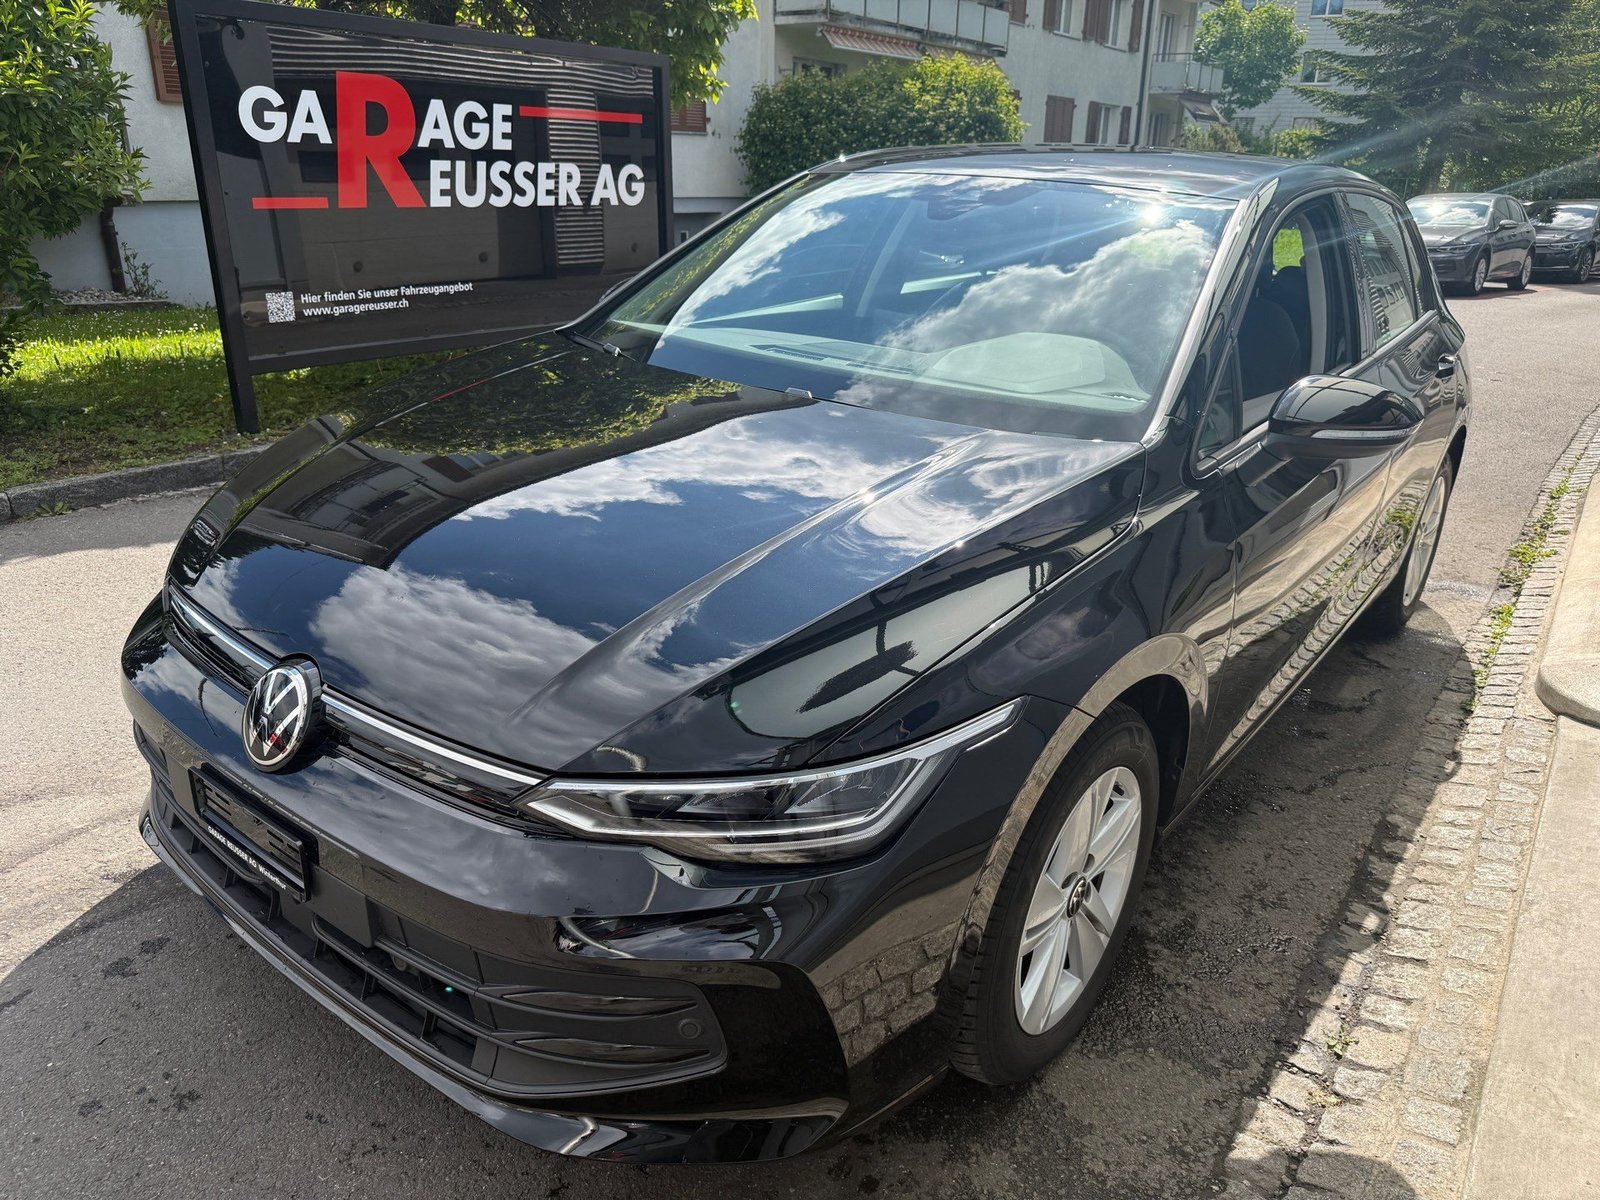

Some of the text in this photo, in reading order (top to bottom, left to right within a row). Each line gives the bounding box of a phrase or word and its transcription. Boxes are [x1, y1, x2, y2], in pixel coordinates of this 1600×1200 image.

[238, 71, 513, 208] GARAGE
[590, 163, 646, 207] AG
[301, 283, 473, 304] Hier finden Sie unser Fahrzeugangebot
[303, 299, 409, 316] www.garagereusser.ch
[208, 825, 286, 889] GARAGE REUSSER AG Winterthur
